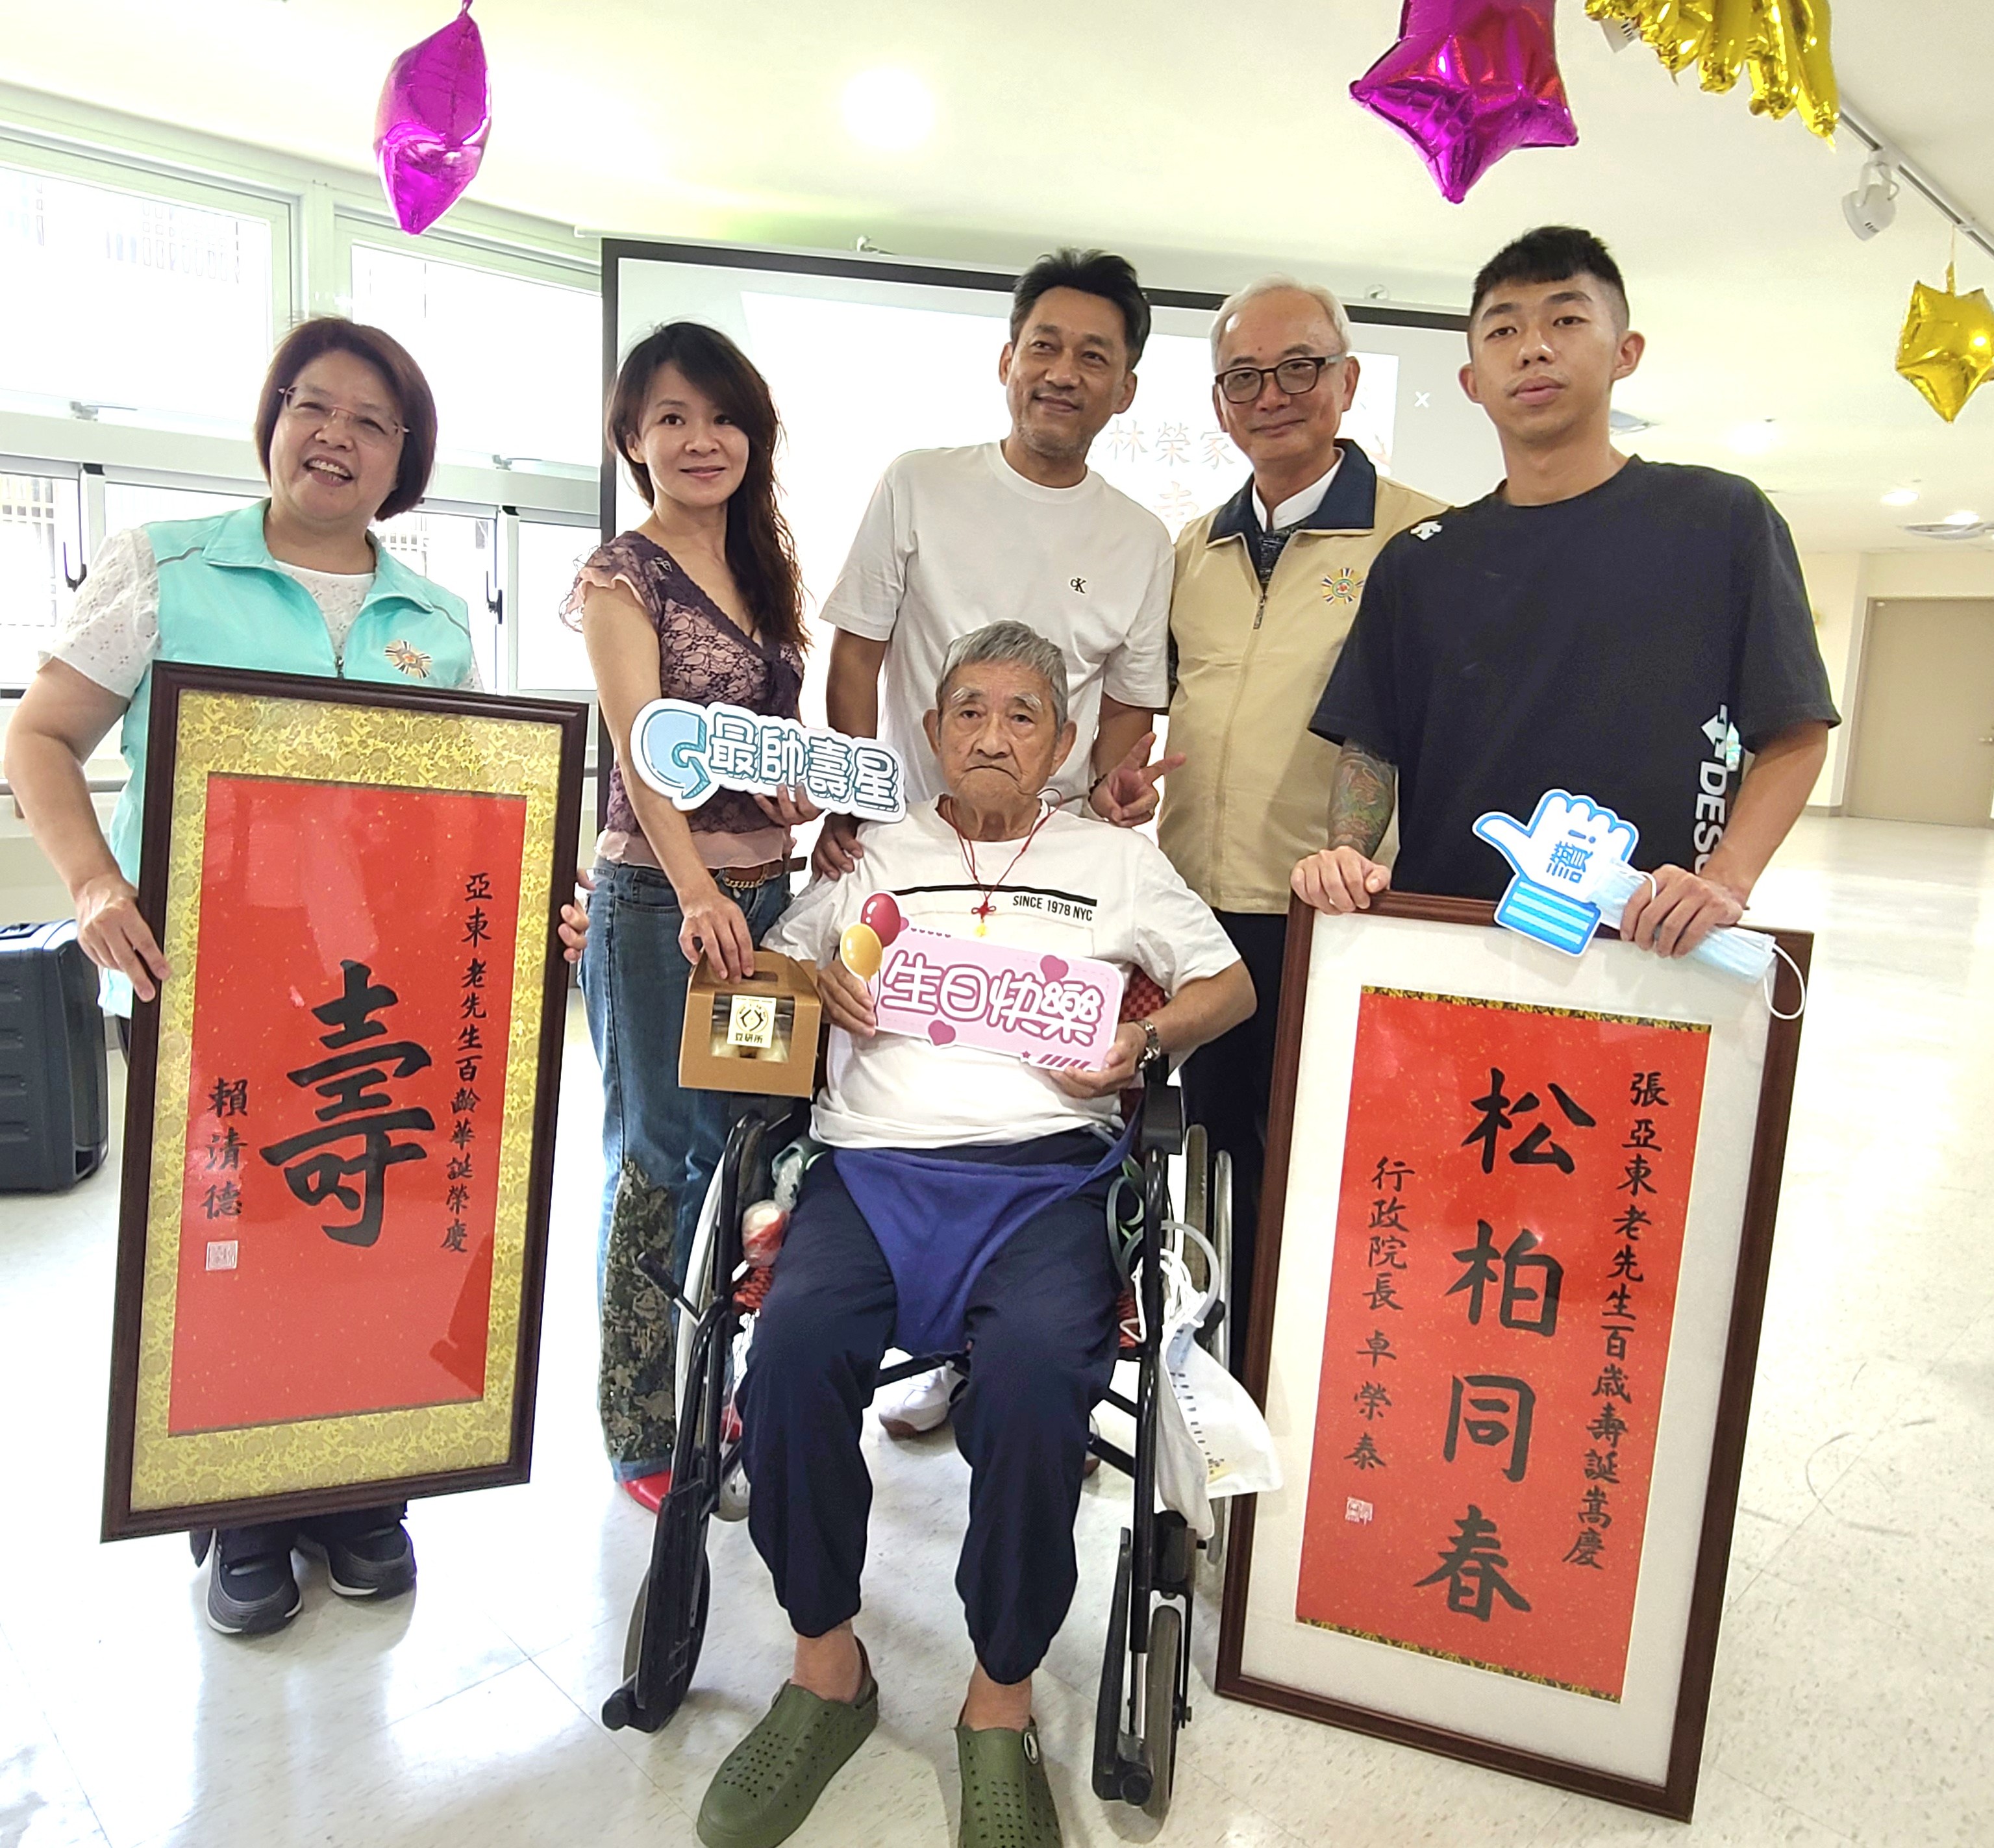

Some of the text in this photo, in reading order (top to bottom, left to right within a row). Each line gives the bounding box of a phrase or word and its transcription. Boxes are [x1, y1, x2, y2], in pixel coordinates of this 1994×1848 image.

[710, 712, 899, 812] 最帥壽星
[1013, 895, 1093, 921] SINCE 1978 NYC
[881, 949, 1104, 1047] 生日快樂
[201, 1077, 248, 1220] 賴清德
[259, 959, 436, 1247] 壽
[1413, 1067, 1597, 1623] 松柏同春
